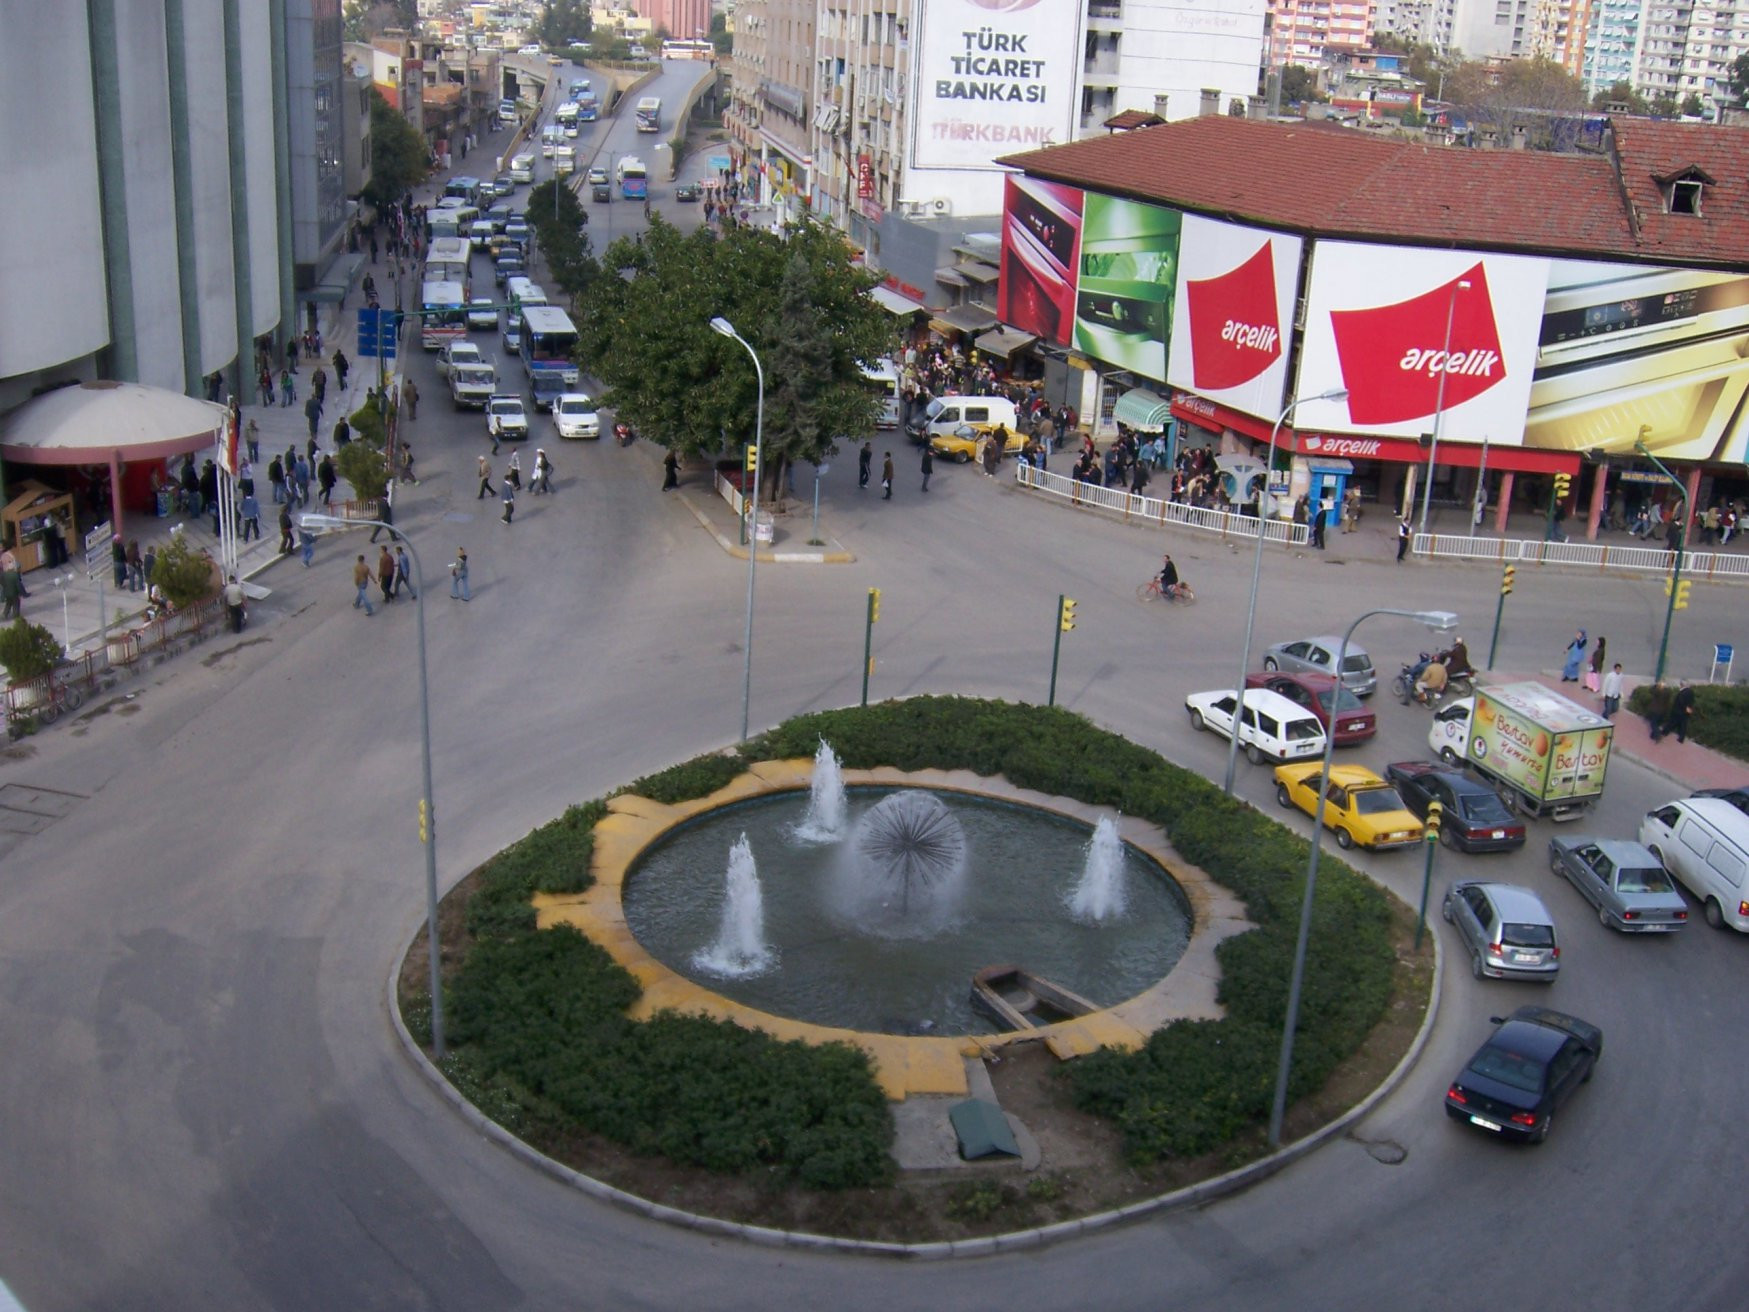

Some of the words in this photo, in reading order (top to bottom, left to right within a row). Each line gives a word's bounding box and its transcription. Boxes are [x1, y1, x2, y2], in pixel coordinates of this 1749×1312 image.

[962, 26, 1028, 53] TÜRK
[950, 51, 1046, 78] TİCARET
[935, 79, 1047, 104] BANKASI
[1221, 319, 1278, 353] arçelik
[1399, 347, 1499, 378] arçelik
[1322, 437, 1382, 456] arçelik
